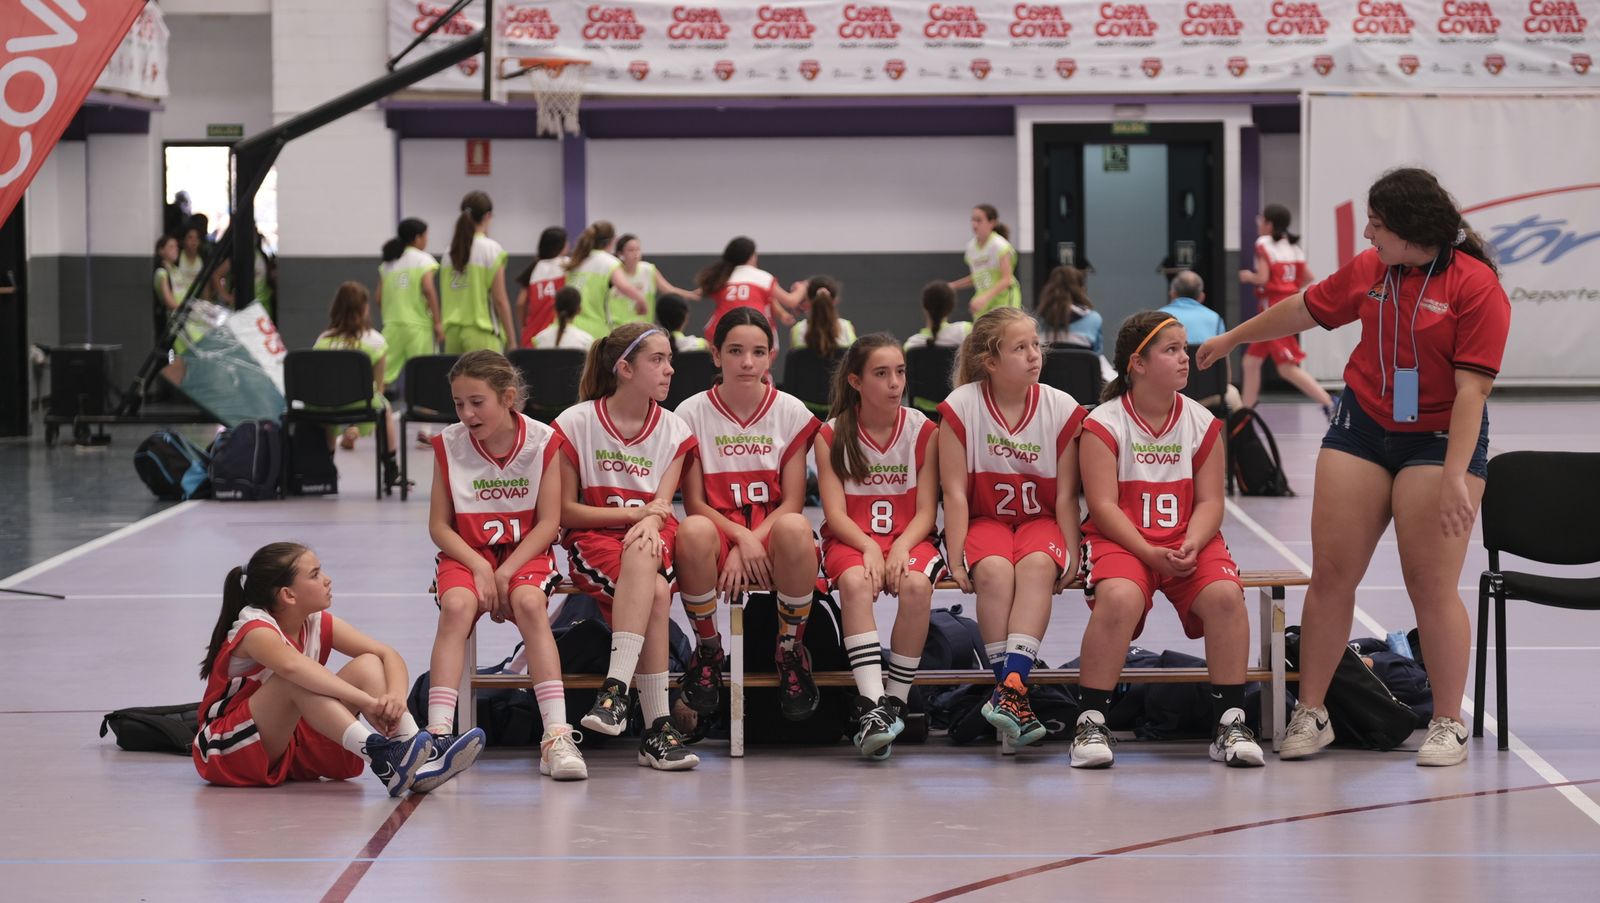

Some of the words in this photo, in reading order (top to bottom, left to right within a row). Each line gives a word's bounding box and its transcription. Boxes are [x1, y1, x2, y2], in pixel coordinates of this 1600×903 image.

[586, 4, 637, 24] COPA
[672, 5, 724, 24] COPA
[756, 4, 809, 23] COPA
[843, 3, 893, 22] COPA
[928, 3, 979, 22] COPA
[1014, 2, 1064, 21] COPA
[1099, 2, 1150, 20] COPA
[1184, 1, 1237, 20] COPA
[1270, 0, 1323, 19] COPA
[1356, 0, 1408, 18] COPA
[1442, 0, 1494, 18] COPA
[1529, 0, 1581, 17] COPA
[581, 24, 646, 41] COVAP
[666, 24, 731, 41] COVAP
[752, 23, 816, 40] COVAP
[837, 22, 902, 40] COVAP
[923, 22, 987, 39] COVAP
[1008, 21, 1072, 39] COVAP
[1094, 20, 1159, 38] COVAP
[1179, 20, 1244, 37] COVAP
[1266, 19, 1330, 36] COVAP
[1352, 18, 1416, 36] COVAP
[1436, 18, 1501, 35] COVAP
[1523, 17, 1588, 33] COVAP
[536, 281, 557, 301] 14
[725, 284, 751, 301] 20
[715, 434, 774, 446] Muévete
[595, 450, 653, 468] Muévete
[723, 444, 772, 456] COVAP
[993, 444, 1039, 464] COVAP
[1136, 452, 1181, 465] COVAP
[602, 459, 650, 478] COVAP
[472, 477, 530, 490] Muévete
[479, 487, 529, 501] COVAP
[730, 481, 770, 509] 19
[994, 481, 1042, 516] 20
[871, 500, 894, 535] 8
[1142, 492, 1180, 529] 19
[482, 518, 523, 546] 21
